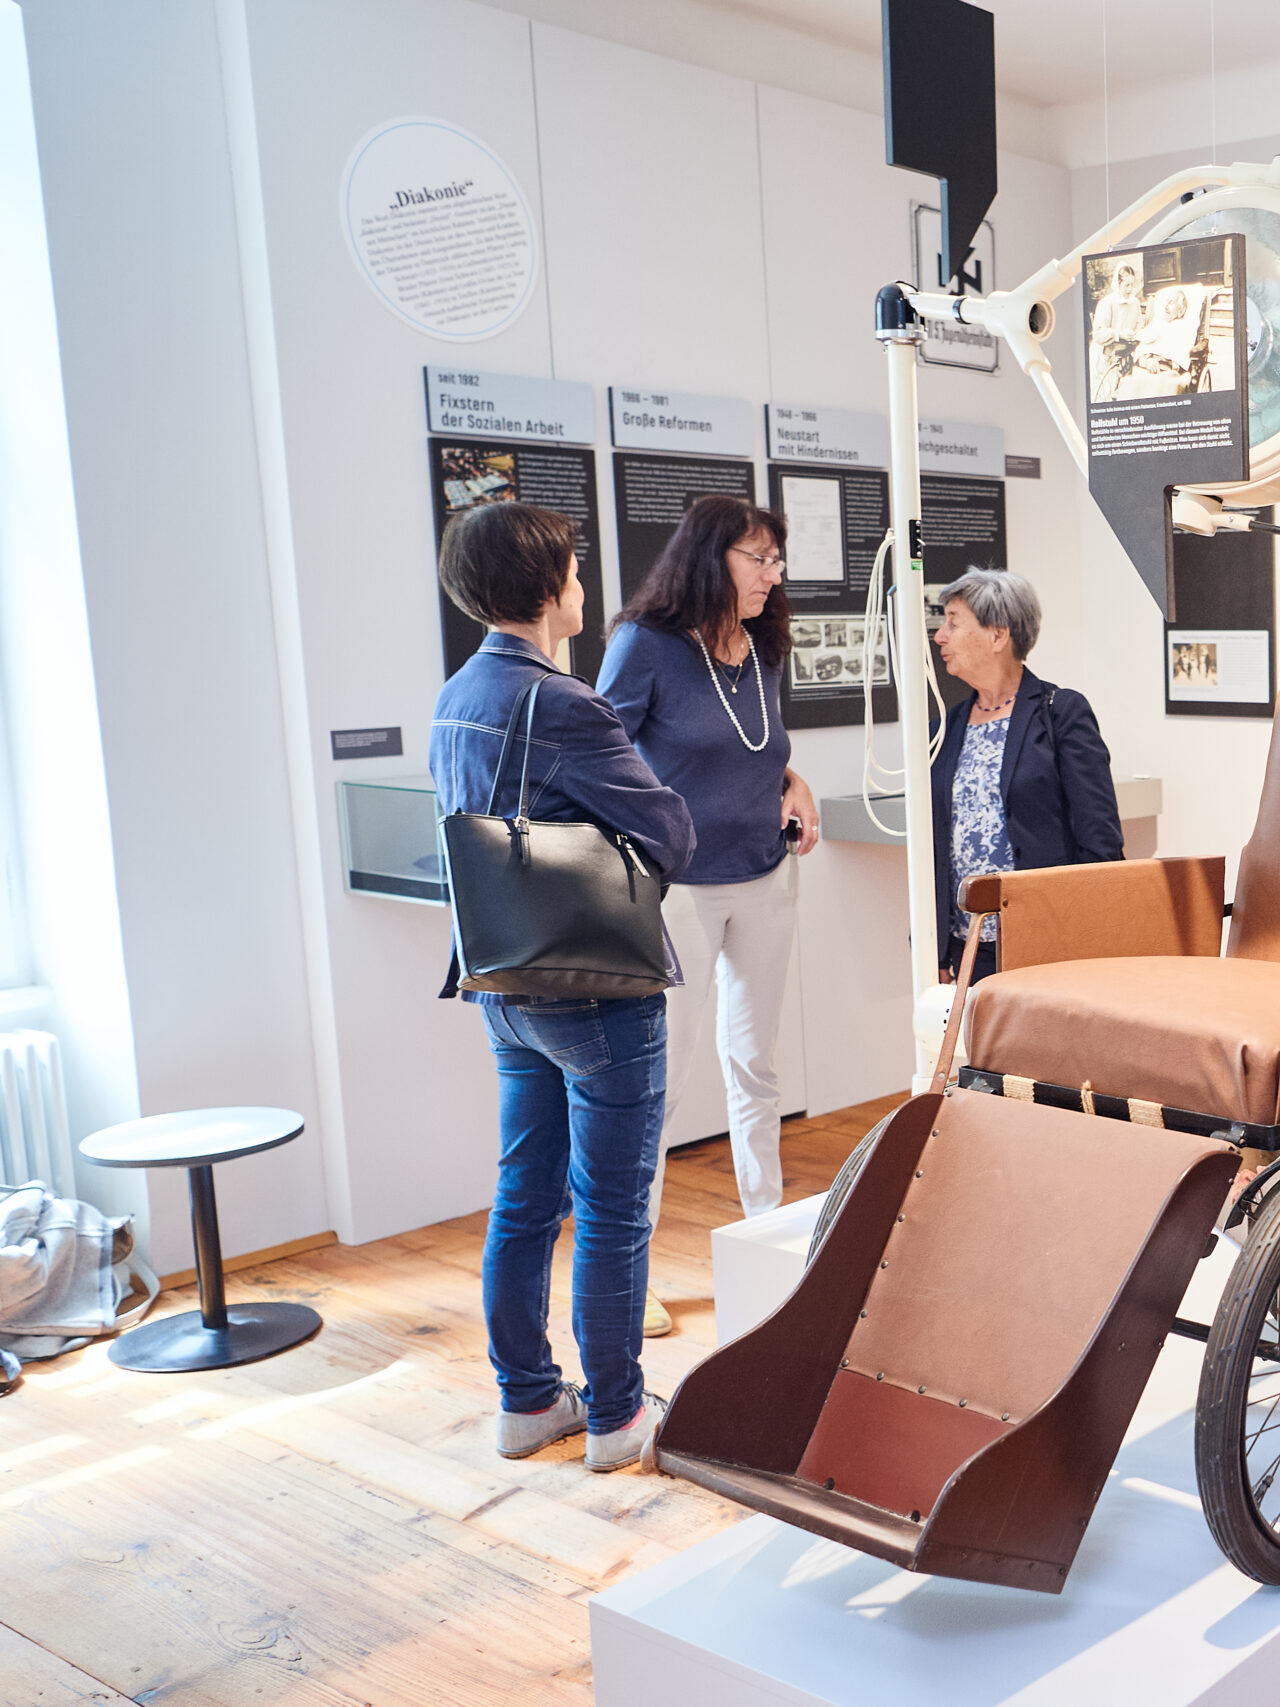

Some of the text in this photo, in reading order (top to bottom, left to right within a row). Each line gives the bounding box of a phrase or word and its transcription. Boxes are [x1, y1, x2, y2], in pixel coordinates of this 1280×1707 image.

[438, 373, 456, 385] seit
[440, 394, 495, 412] Fixstern
[441, 411, 565, 437] der Sozialen Arbeit
[623, 412, 712, 432] Große Reformen
[778, 428, 820, 443] Neustart
[797, 445, 859, 460] Hindernissen
